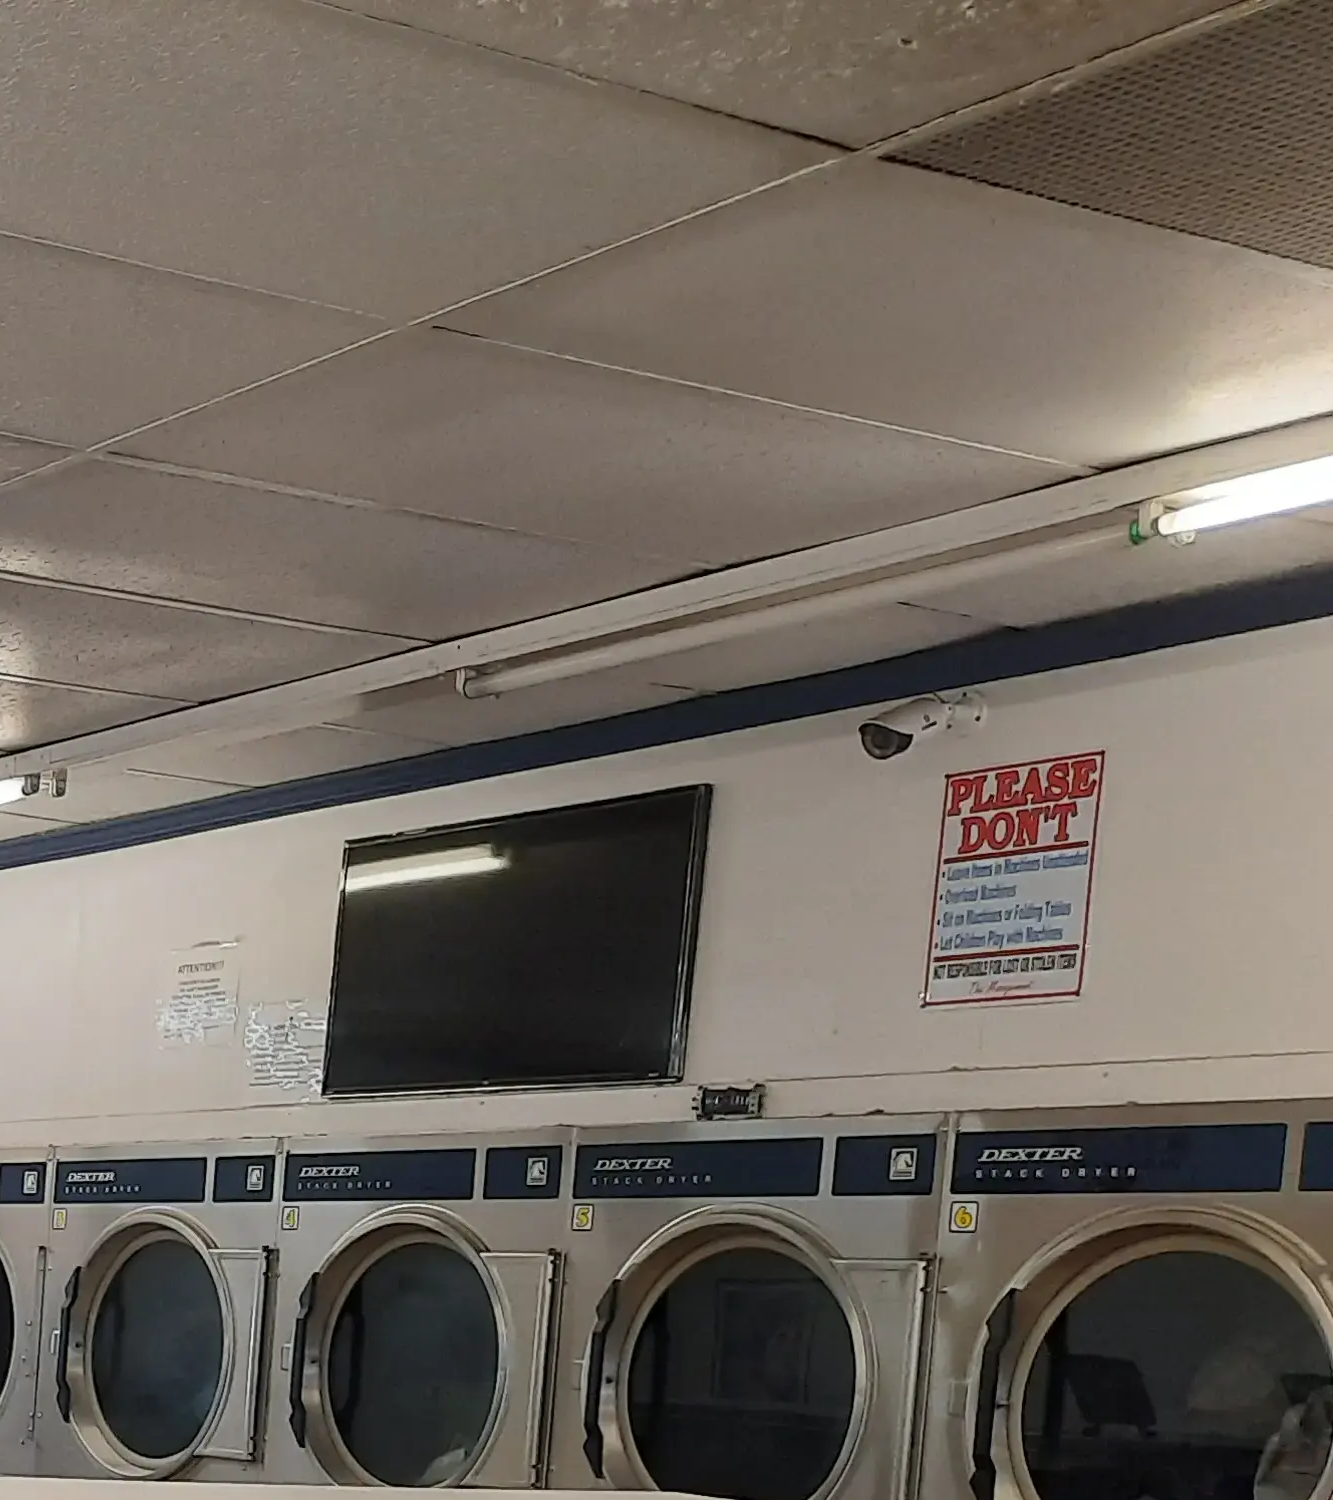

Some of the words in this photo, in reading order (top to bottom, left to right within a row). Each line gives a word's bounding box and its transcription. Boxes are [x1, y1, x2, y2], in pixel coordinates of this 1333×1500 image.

[947, 758, 1098, 818] PLEASE
[958, 802, 1078, 854] DON'T
[977, 1147, 1083, 1162] DEXTER
[299, 1165, 360, 1177] DEXTER
[594, 1158, 673, 1171] DEXTER
[66, 1171, 116, 1182] DEXTER
[975, 1168, 1045, 1179] STACK
[1061, 1167, 1136, 1178] DRYER
[591, 1176, 643, 1186] STACK
[575, 1207, 590, 1228] 5
[954, 1206, 973, 1229] 6
